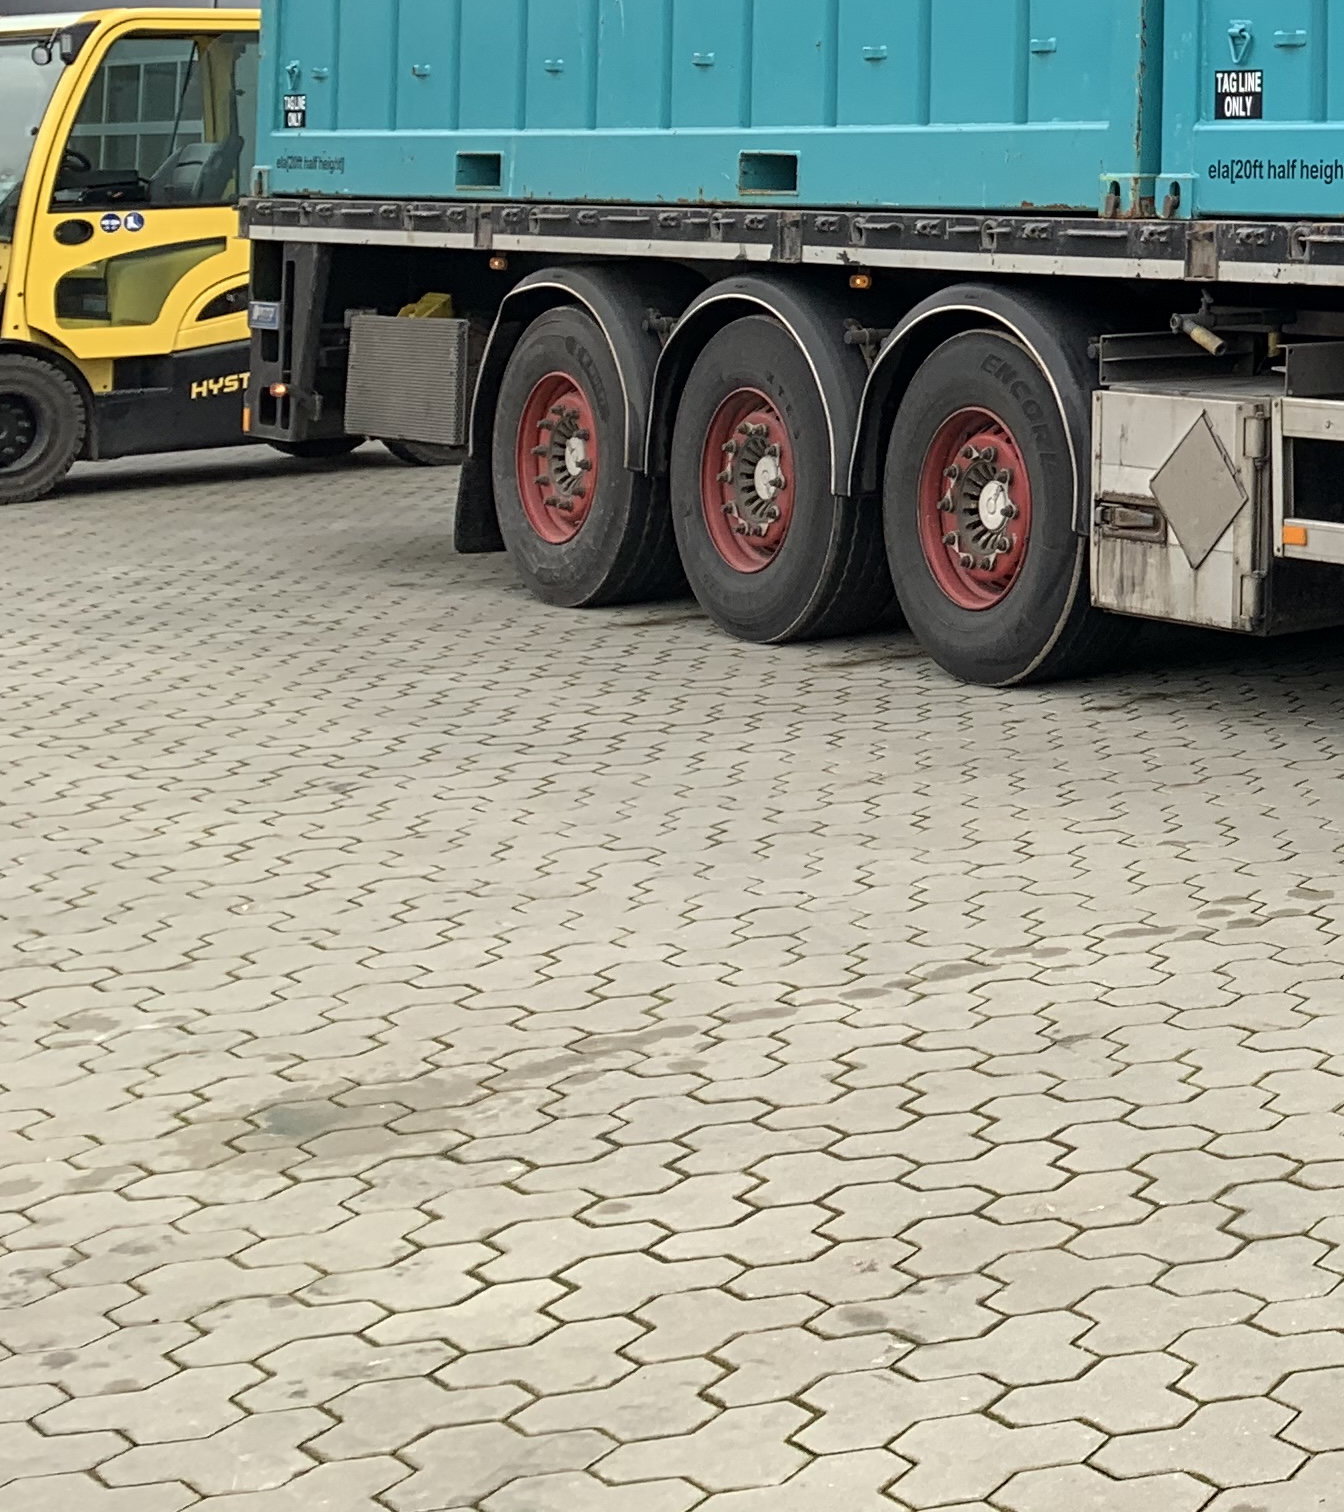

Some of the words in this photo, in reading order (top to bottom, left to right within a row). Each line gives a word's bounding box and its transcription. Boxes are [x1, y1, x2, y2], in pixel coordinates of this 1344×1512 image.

[1216, 72, 1237, 93] TAG
[1238, 71, 1262, 93] LINE
[1224, 96, 1253, 117] ONLY
[1208, 159, 1264, 185] ela[20ft
[1267, 159, 1298, 180] half
